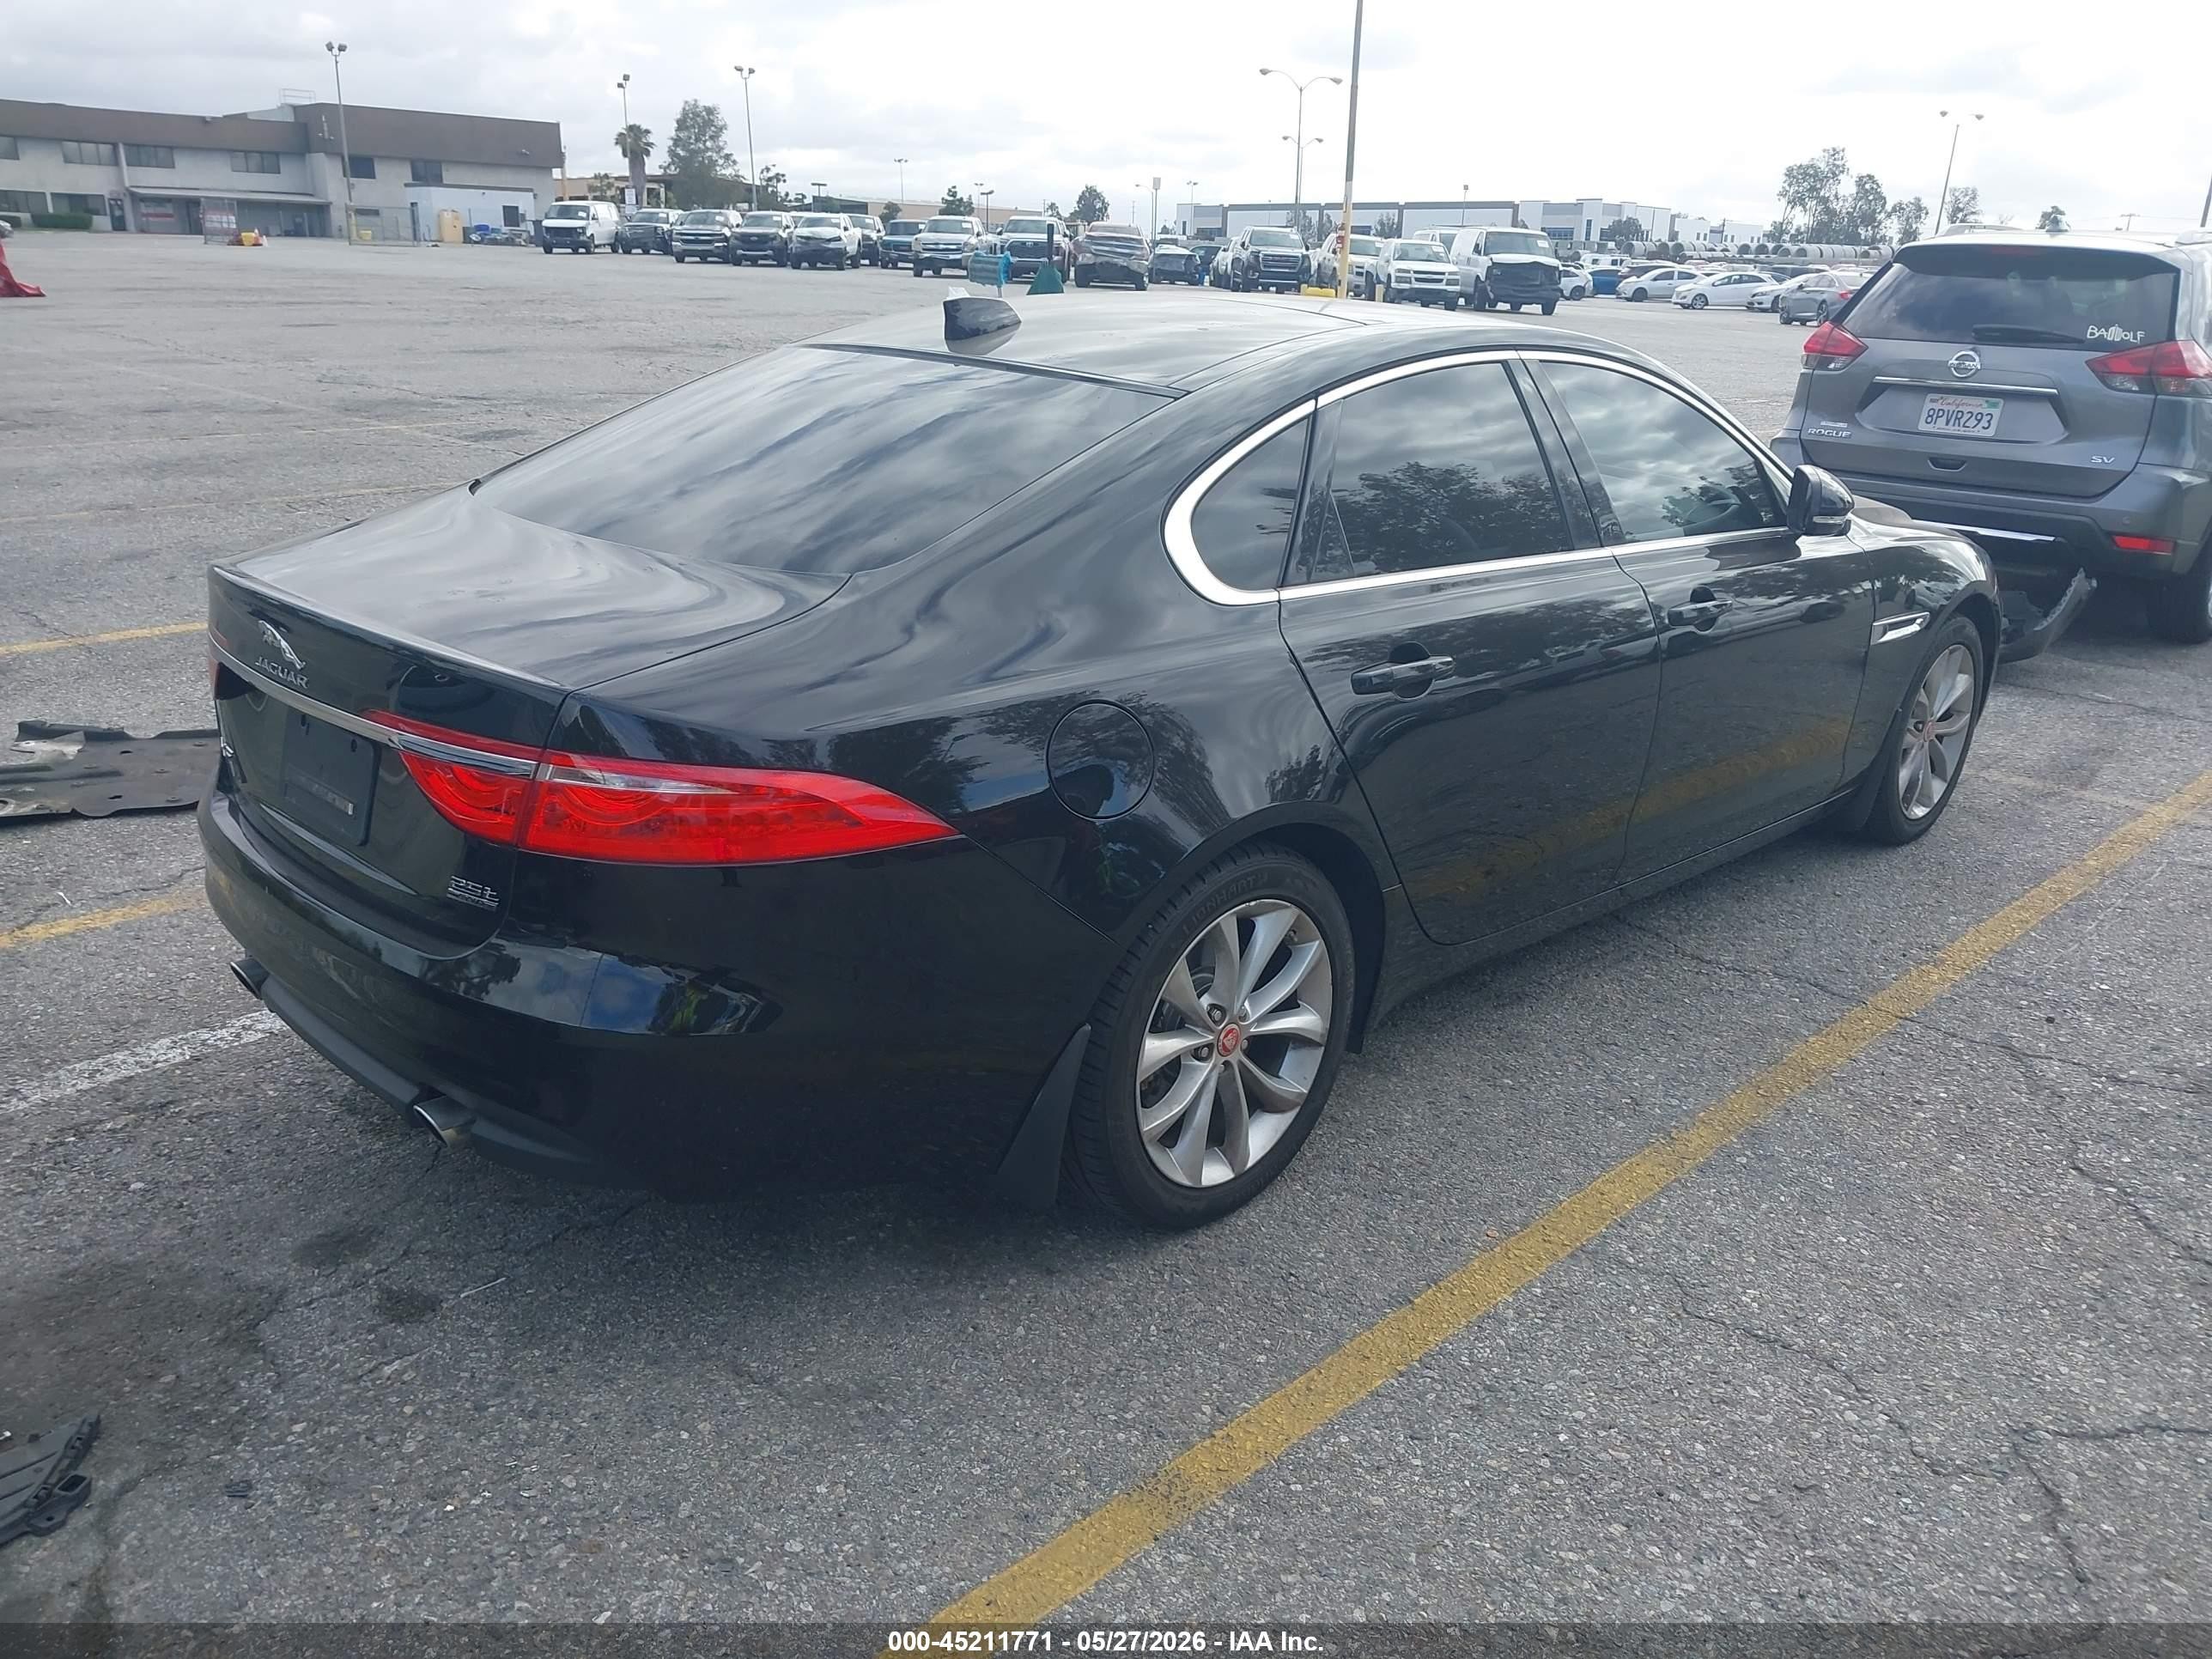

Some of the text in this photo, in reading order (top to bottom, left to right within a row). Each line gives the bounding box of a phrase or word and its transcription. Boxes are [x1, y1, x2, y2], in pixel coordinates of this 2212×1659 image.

[1940, 397, 1983, 409] California
[1924, 408, 1994, 430] 8PVR293
[1808, 428, 1852, 438] ROGUE
[2091, 455, 2115, 464] SV
[254, 656, 307, 689] JAGUAR
